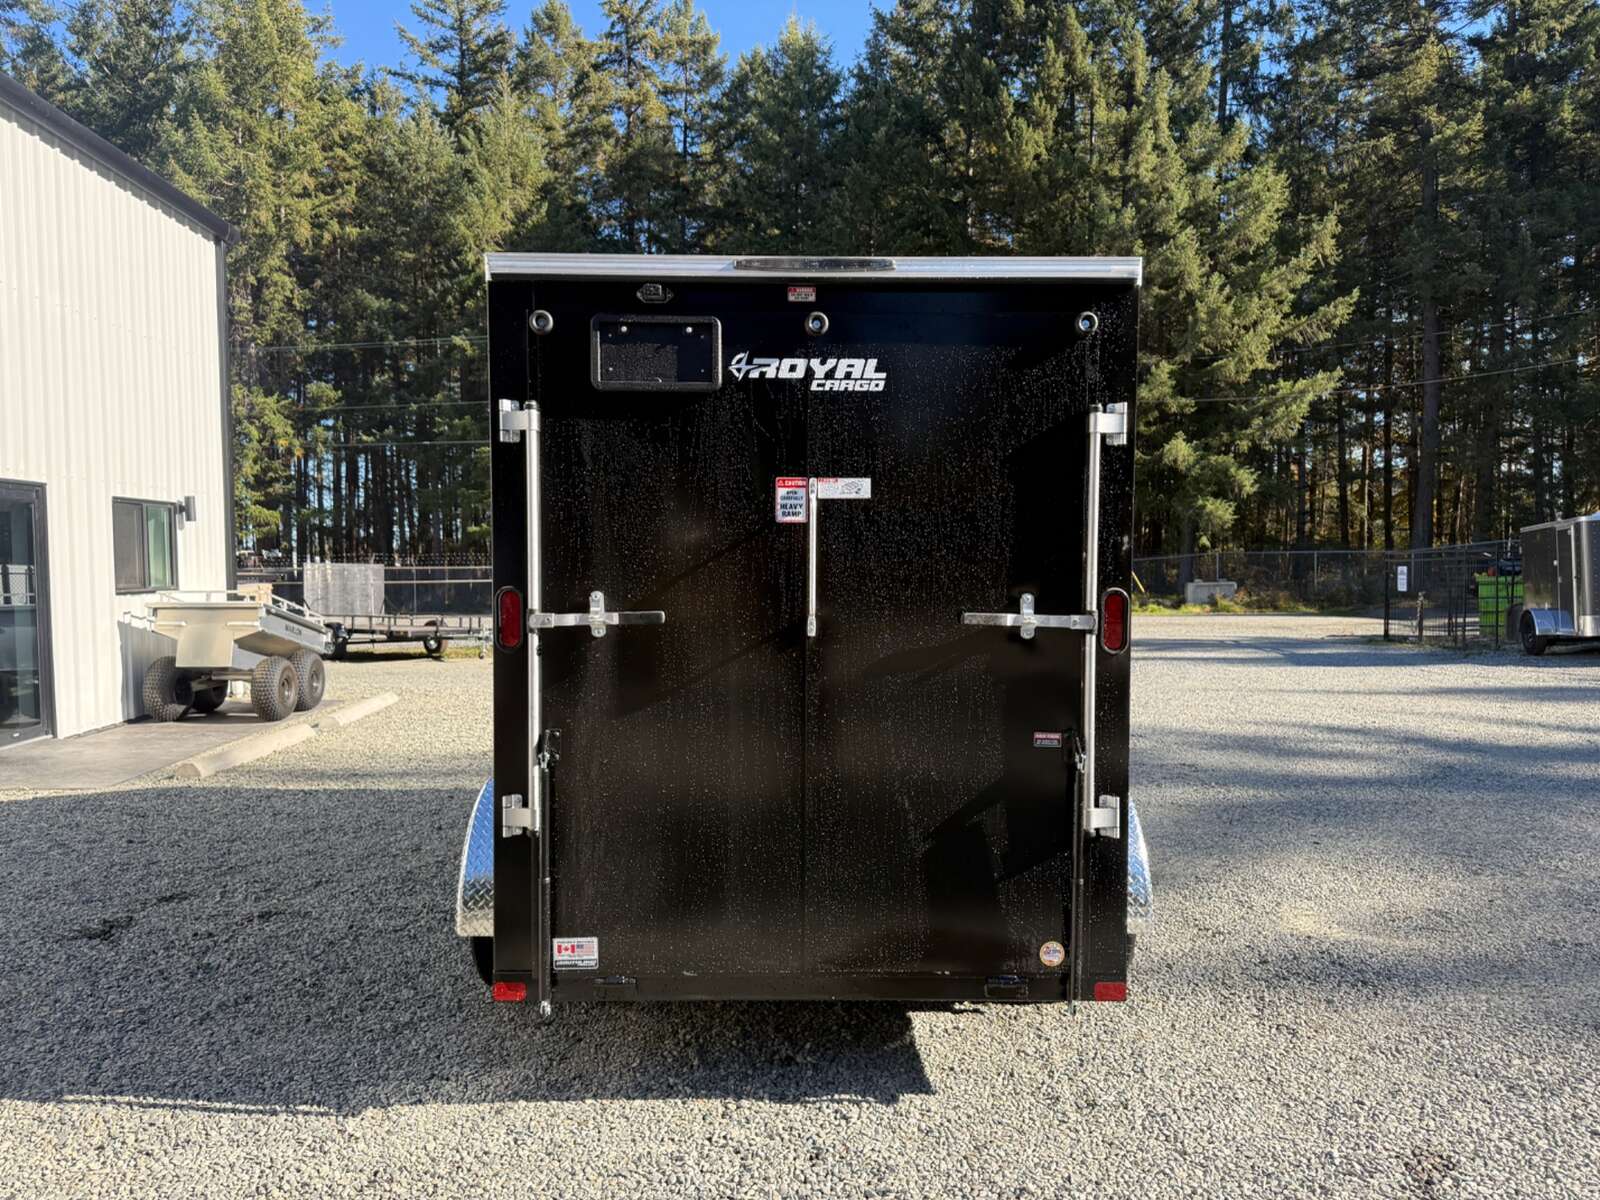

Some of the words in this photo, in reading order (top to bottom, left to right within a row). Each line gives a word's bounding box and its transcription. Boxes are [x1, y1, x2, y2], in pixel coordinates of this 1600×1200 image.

[748, 358, 887, 379] ROYAL
[810, 379, 885, 391] CARGO
[781, 510, 802, 518] RAMP
